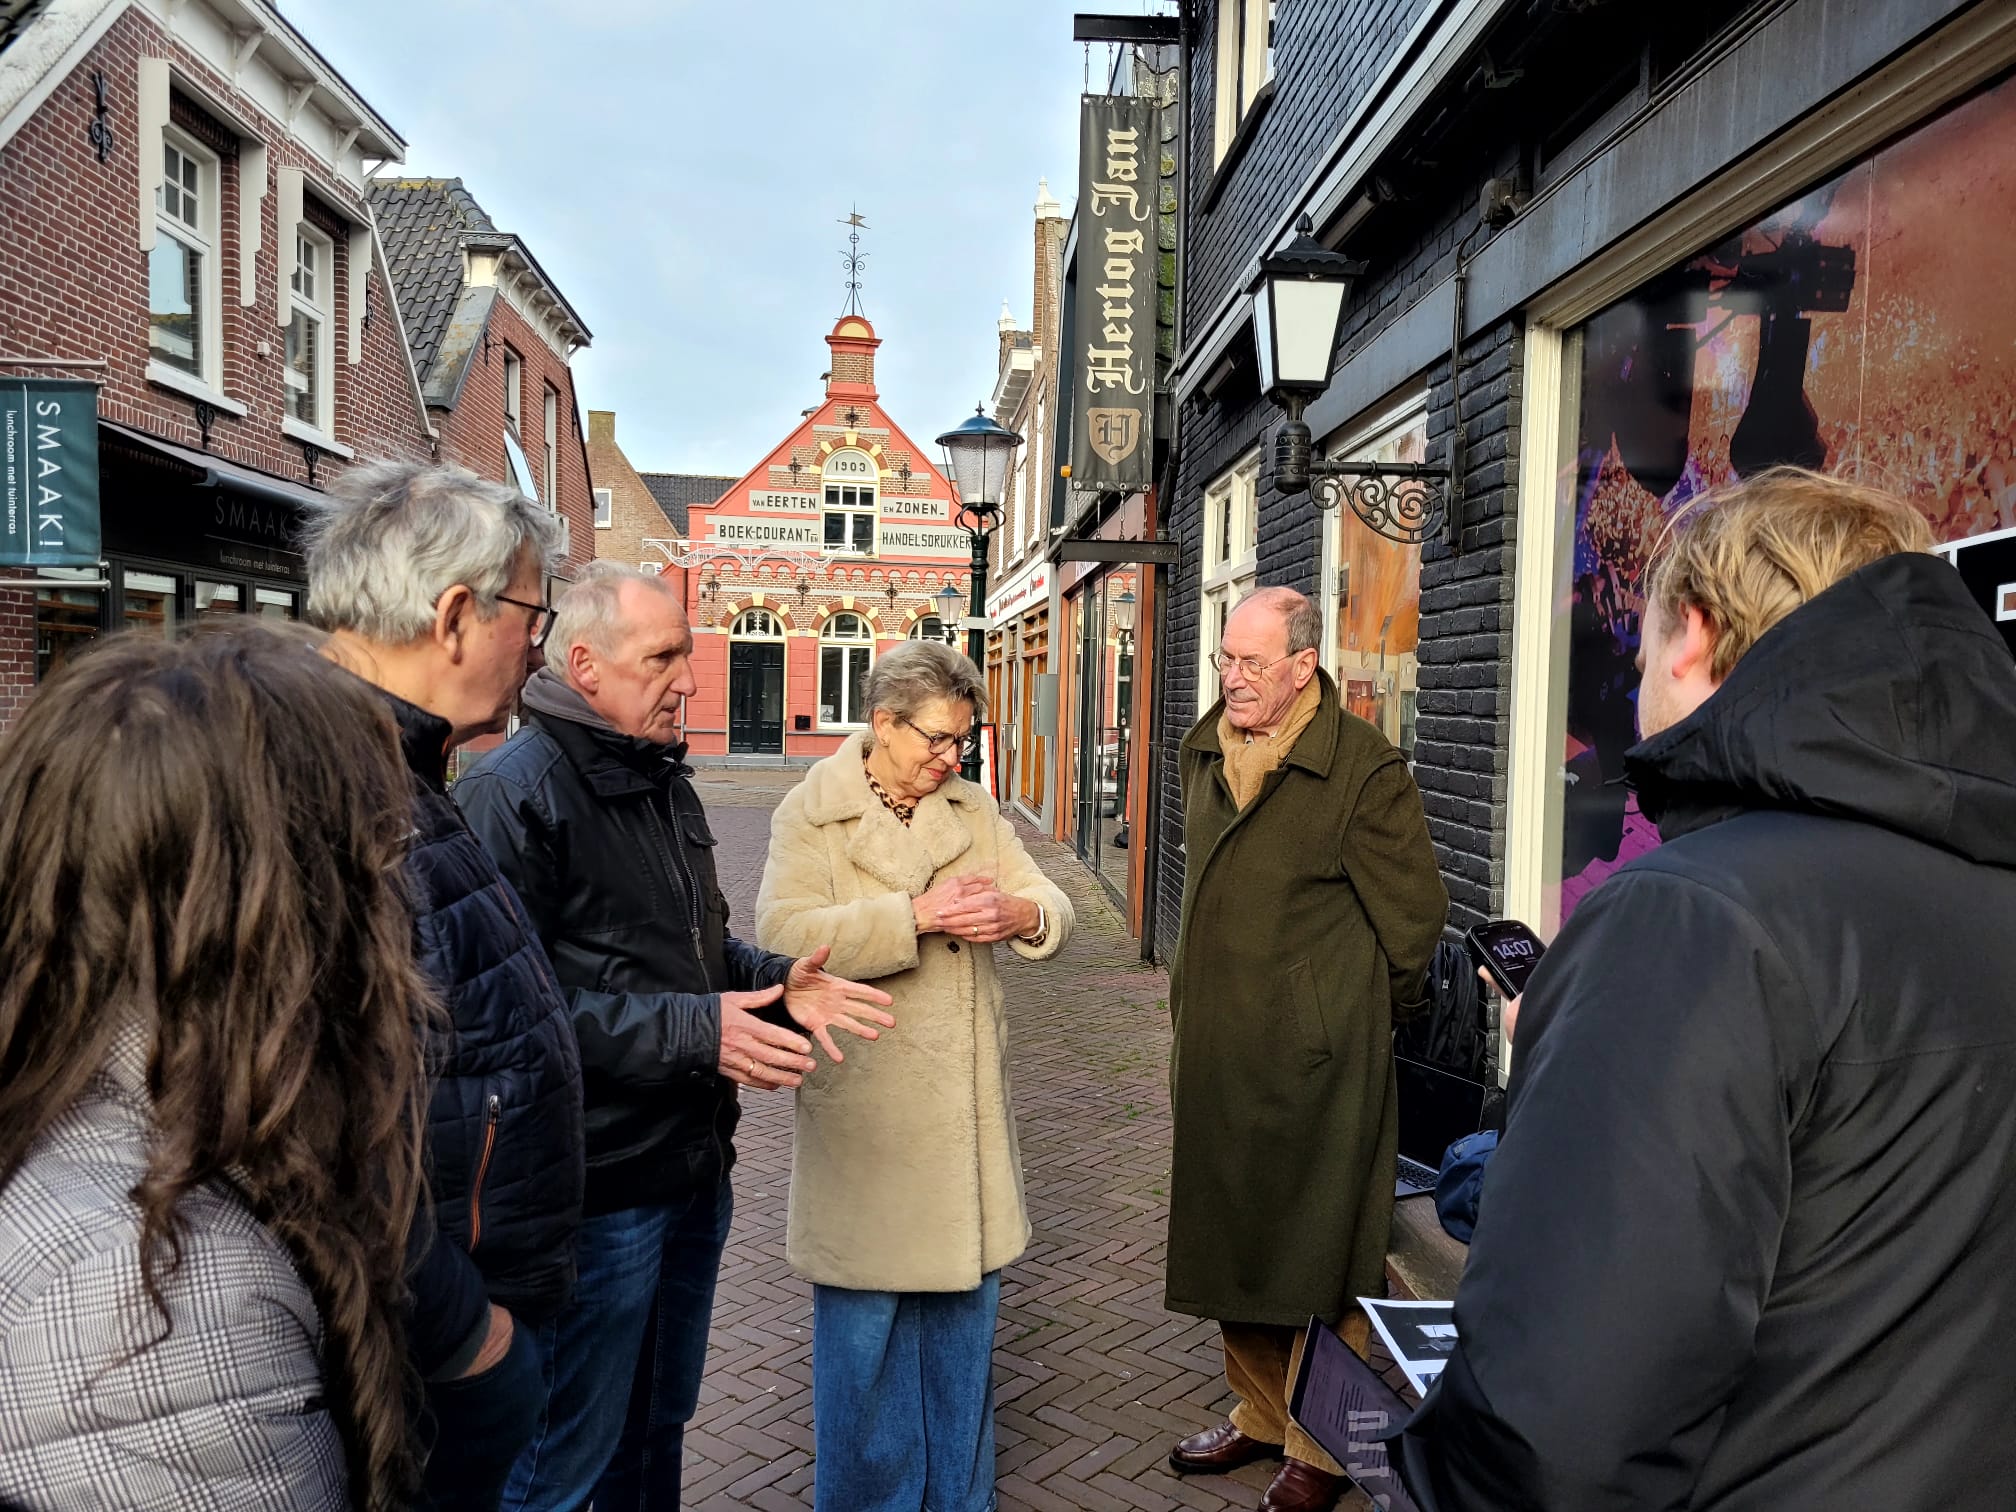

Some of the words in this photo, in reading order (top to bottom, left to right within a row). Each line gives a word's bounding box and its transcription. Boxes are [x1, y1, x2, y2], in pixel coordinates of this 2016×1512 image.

[1091, 126, 1150, 221] Jan
[1086, 227, 1145, 394] Hertog
[6, 410, 17, 463] lunchroom
[7, 467, 17, 484] met
[36, 400, 64, 546] SMAAK!
[835, 461, 866, 472] 1903
[8, 488, 18, 535] tuinterras
[752, 499, 765, 507] VAN
[767, 495, 816, 509] EERTEN
[219, 550, 251, 568] lunchroom
[1492, 940, 1534, 960] 14:07
